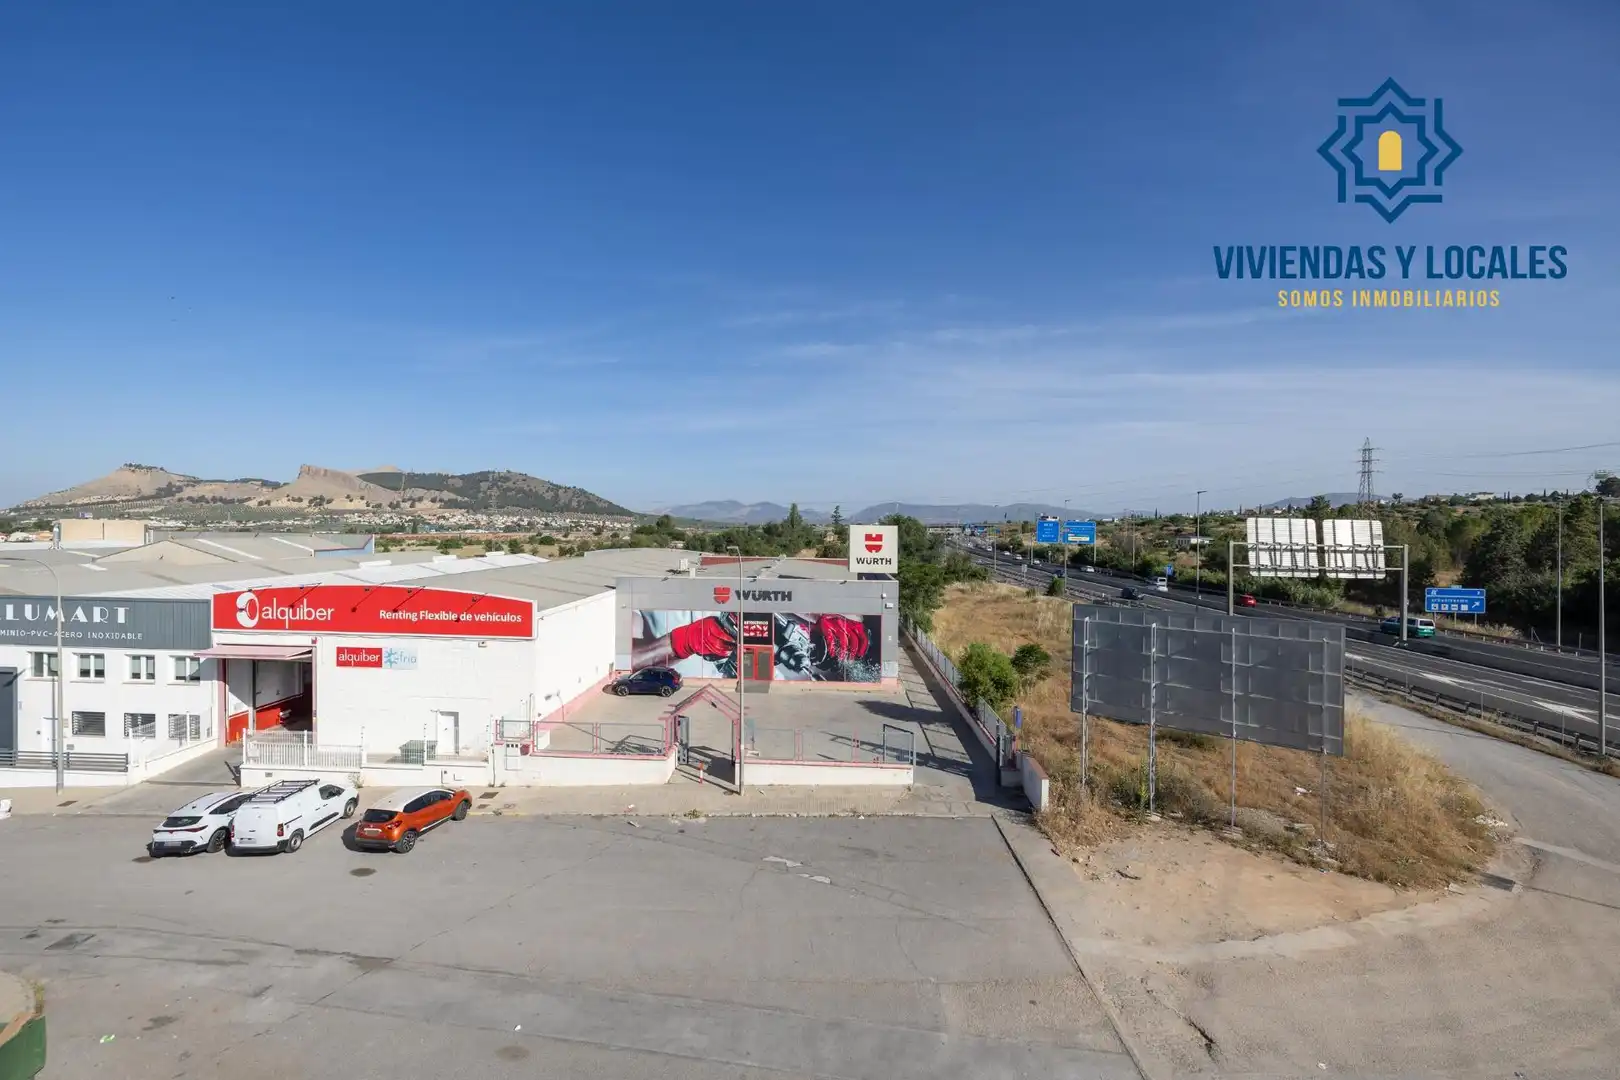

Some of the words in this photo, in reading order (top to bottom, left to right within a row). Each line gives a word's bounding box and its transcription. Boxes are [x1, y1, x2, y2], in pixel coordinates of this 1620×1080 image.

[856, 557, 892, 565] WÜRTH
[735, 590, 792, 602] WÜRTH
[0, 604, 130, 624] LUMART
[261, 597, 334, 629] alquiber
[379, 610, 418, 622] Renting
[419, 610, 458, 621] Flexible
[460, 611, 472, 621] de
[474, 611, 522, 622] vehículos
[87, 631, 143, 640] INOXIDABLE
[338, 648, 380, 667] alquiber
